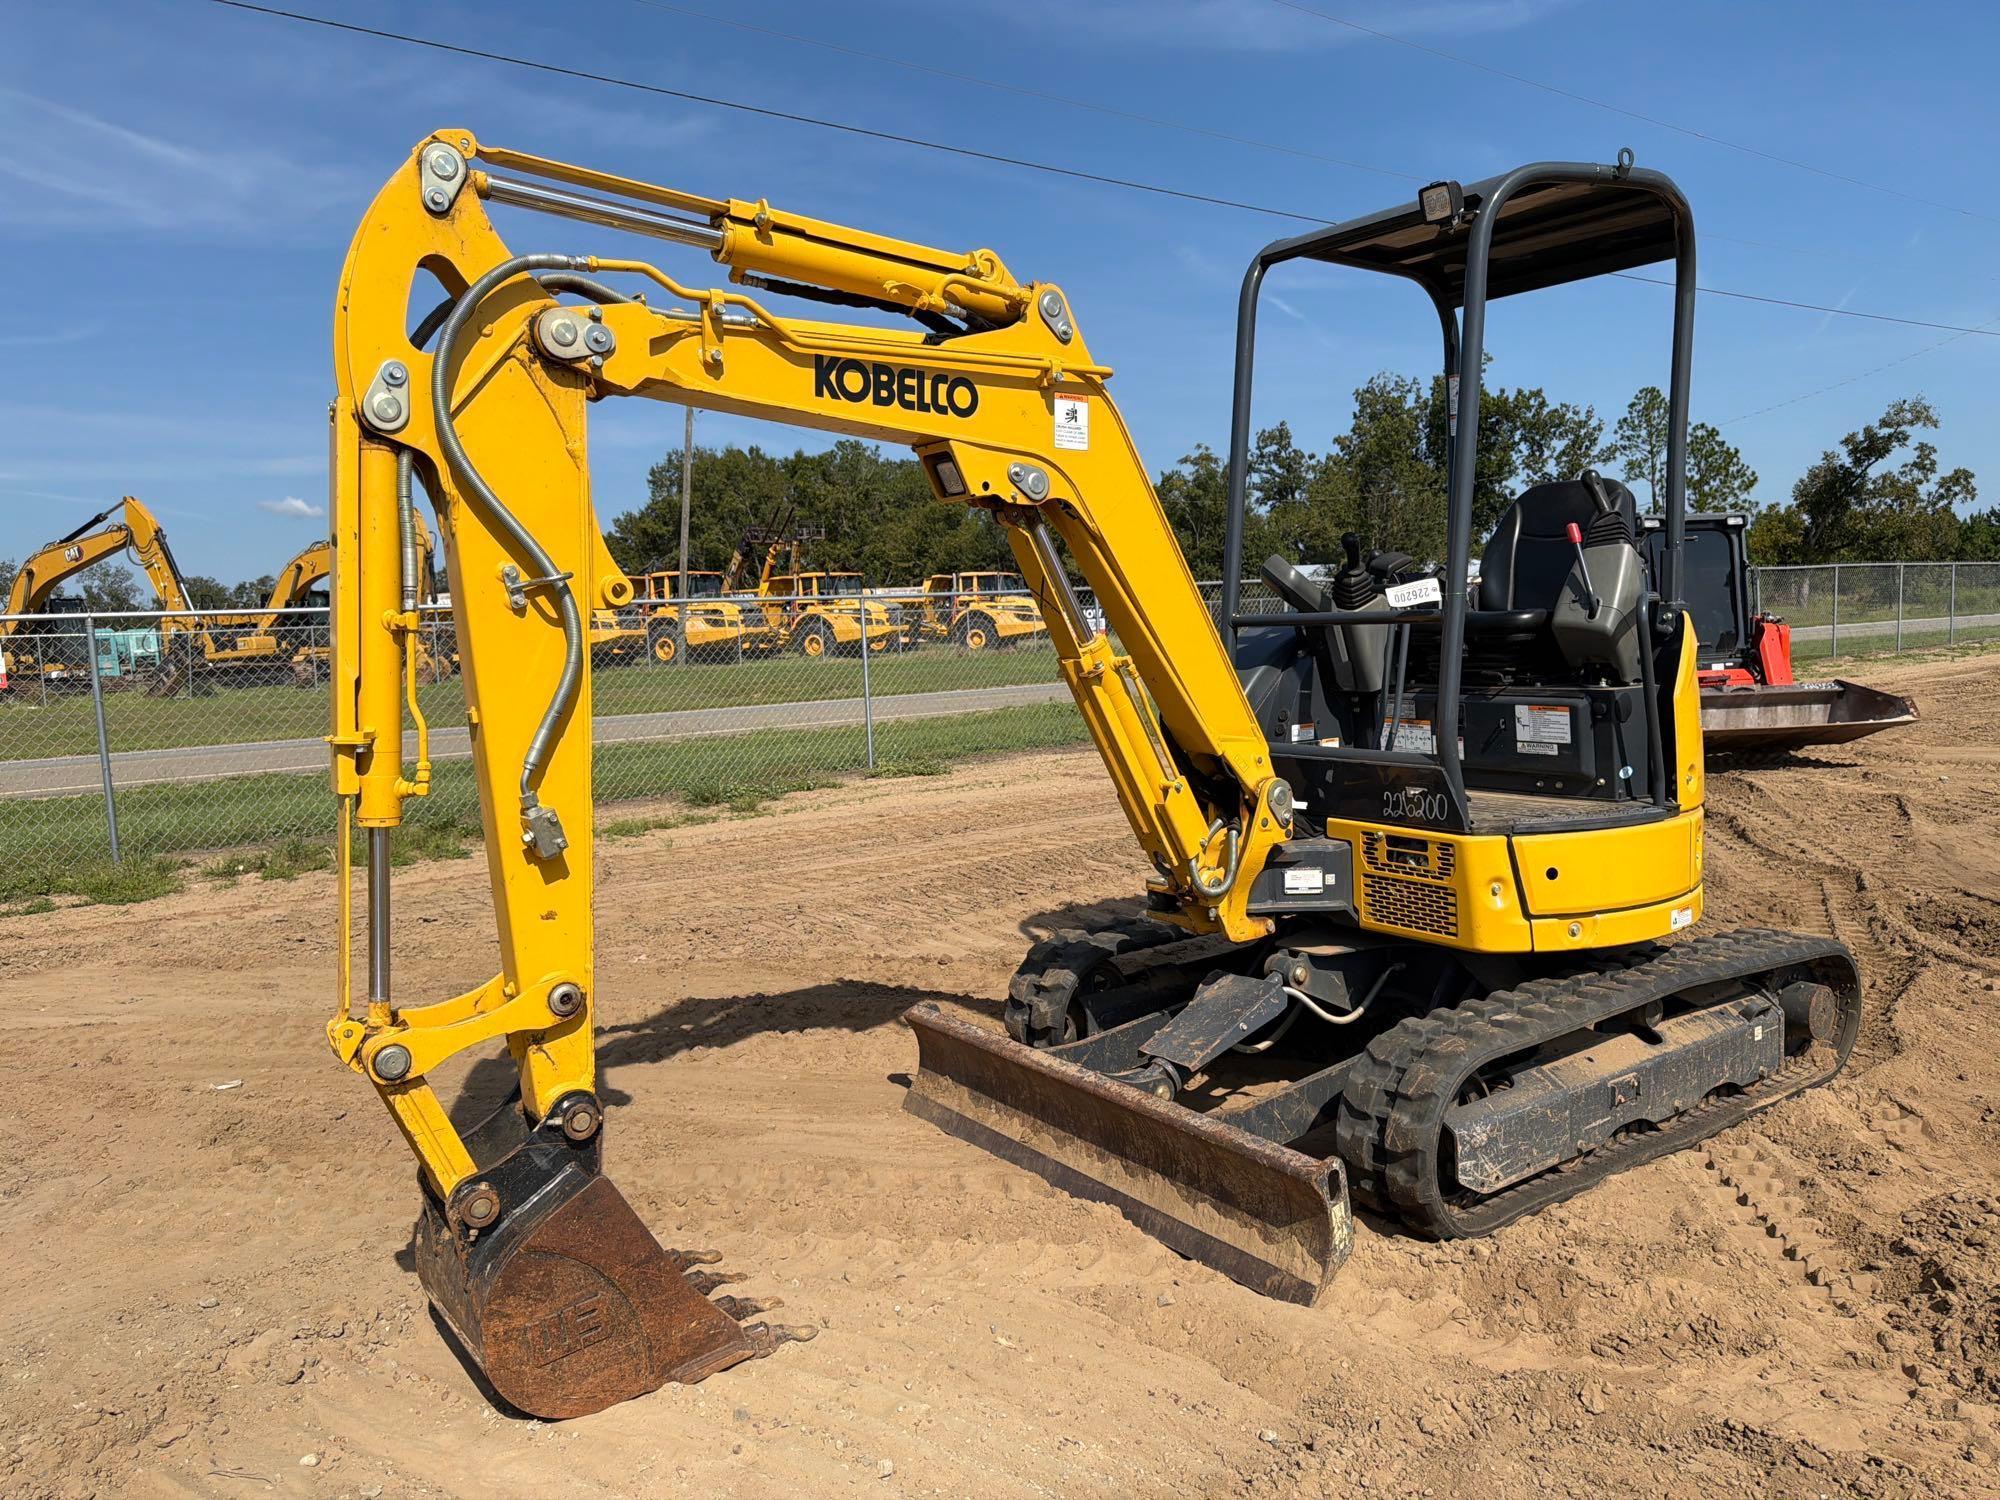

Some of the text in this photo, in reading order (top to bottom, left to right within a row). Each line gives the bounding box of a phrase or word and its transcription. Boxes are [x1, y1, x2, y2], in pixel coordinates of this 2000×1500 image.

[814, 353, 979, 418] KOBELCO
[1394, 587, 1430, 604] 226200
[1526, 742, 1555, 751] WARNING
[1383, 790, 1448, 821] 226200
